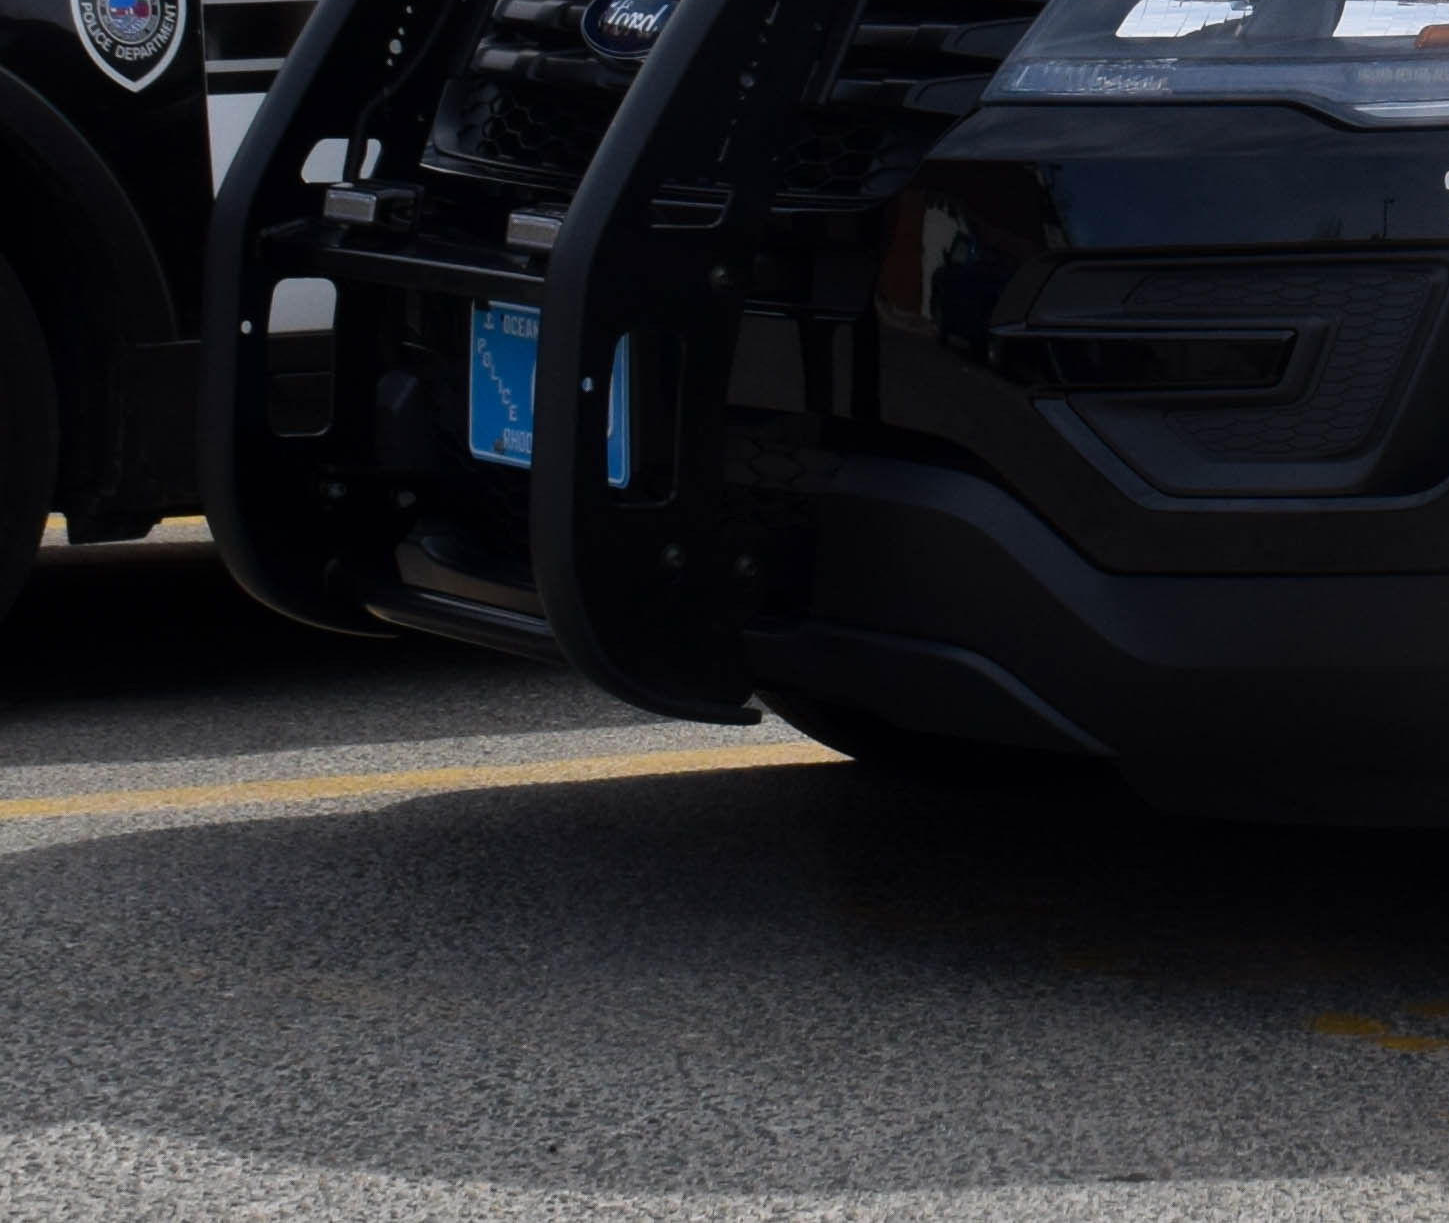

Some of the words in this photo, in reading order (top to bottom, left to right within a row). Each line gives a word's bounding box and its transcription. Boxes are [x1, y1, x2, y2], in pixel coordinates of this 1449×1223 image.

[80, 1, 113, 53] POLICE
[115, 2, 176, 61] DEPARTMENT
[477, 338, 518, 423] POLICE
